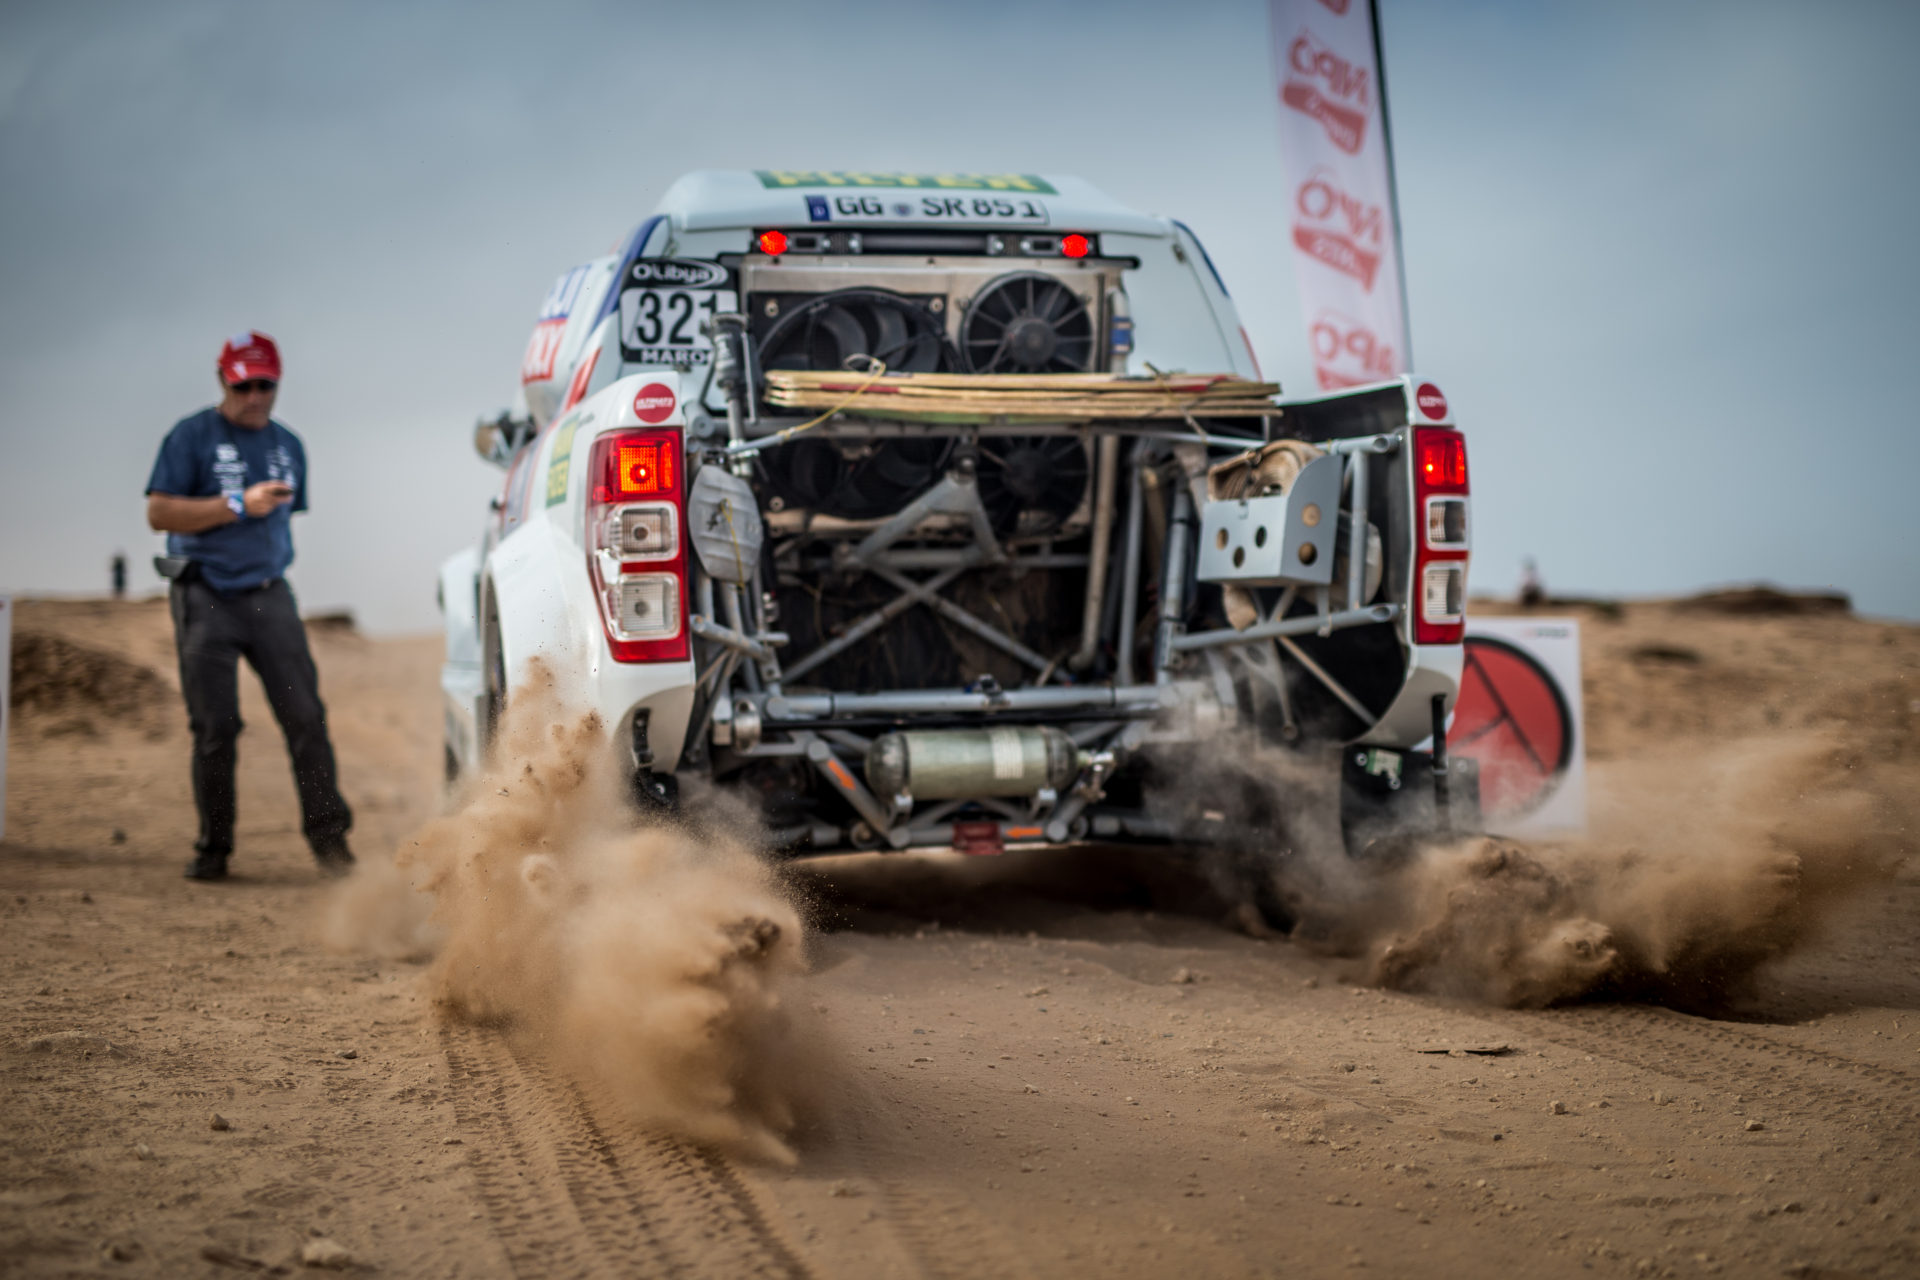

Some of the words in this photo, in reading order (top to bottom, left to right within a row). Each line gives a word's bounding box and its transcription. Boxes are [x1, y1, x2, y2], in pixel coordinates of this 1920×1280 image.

[835, 196, 884, 216] GG
[922, 197, 968, 217] SR
[972, 198, 1041, 218] 851
[641, 349, 713, 364] MARO
